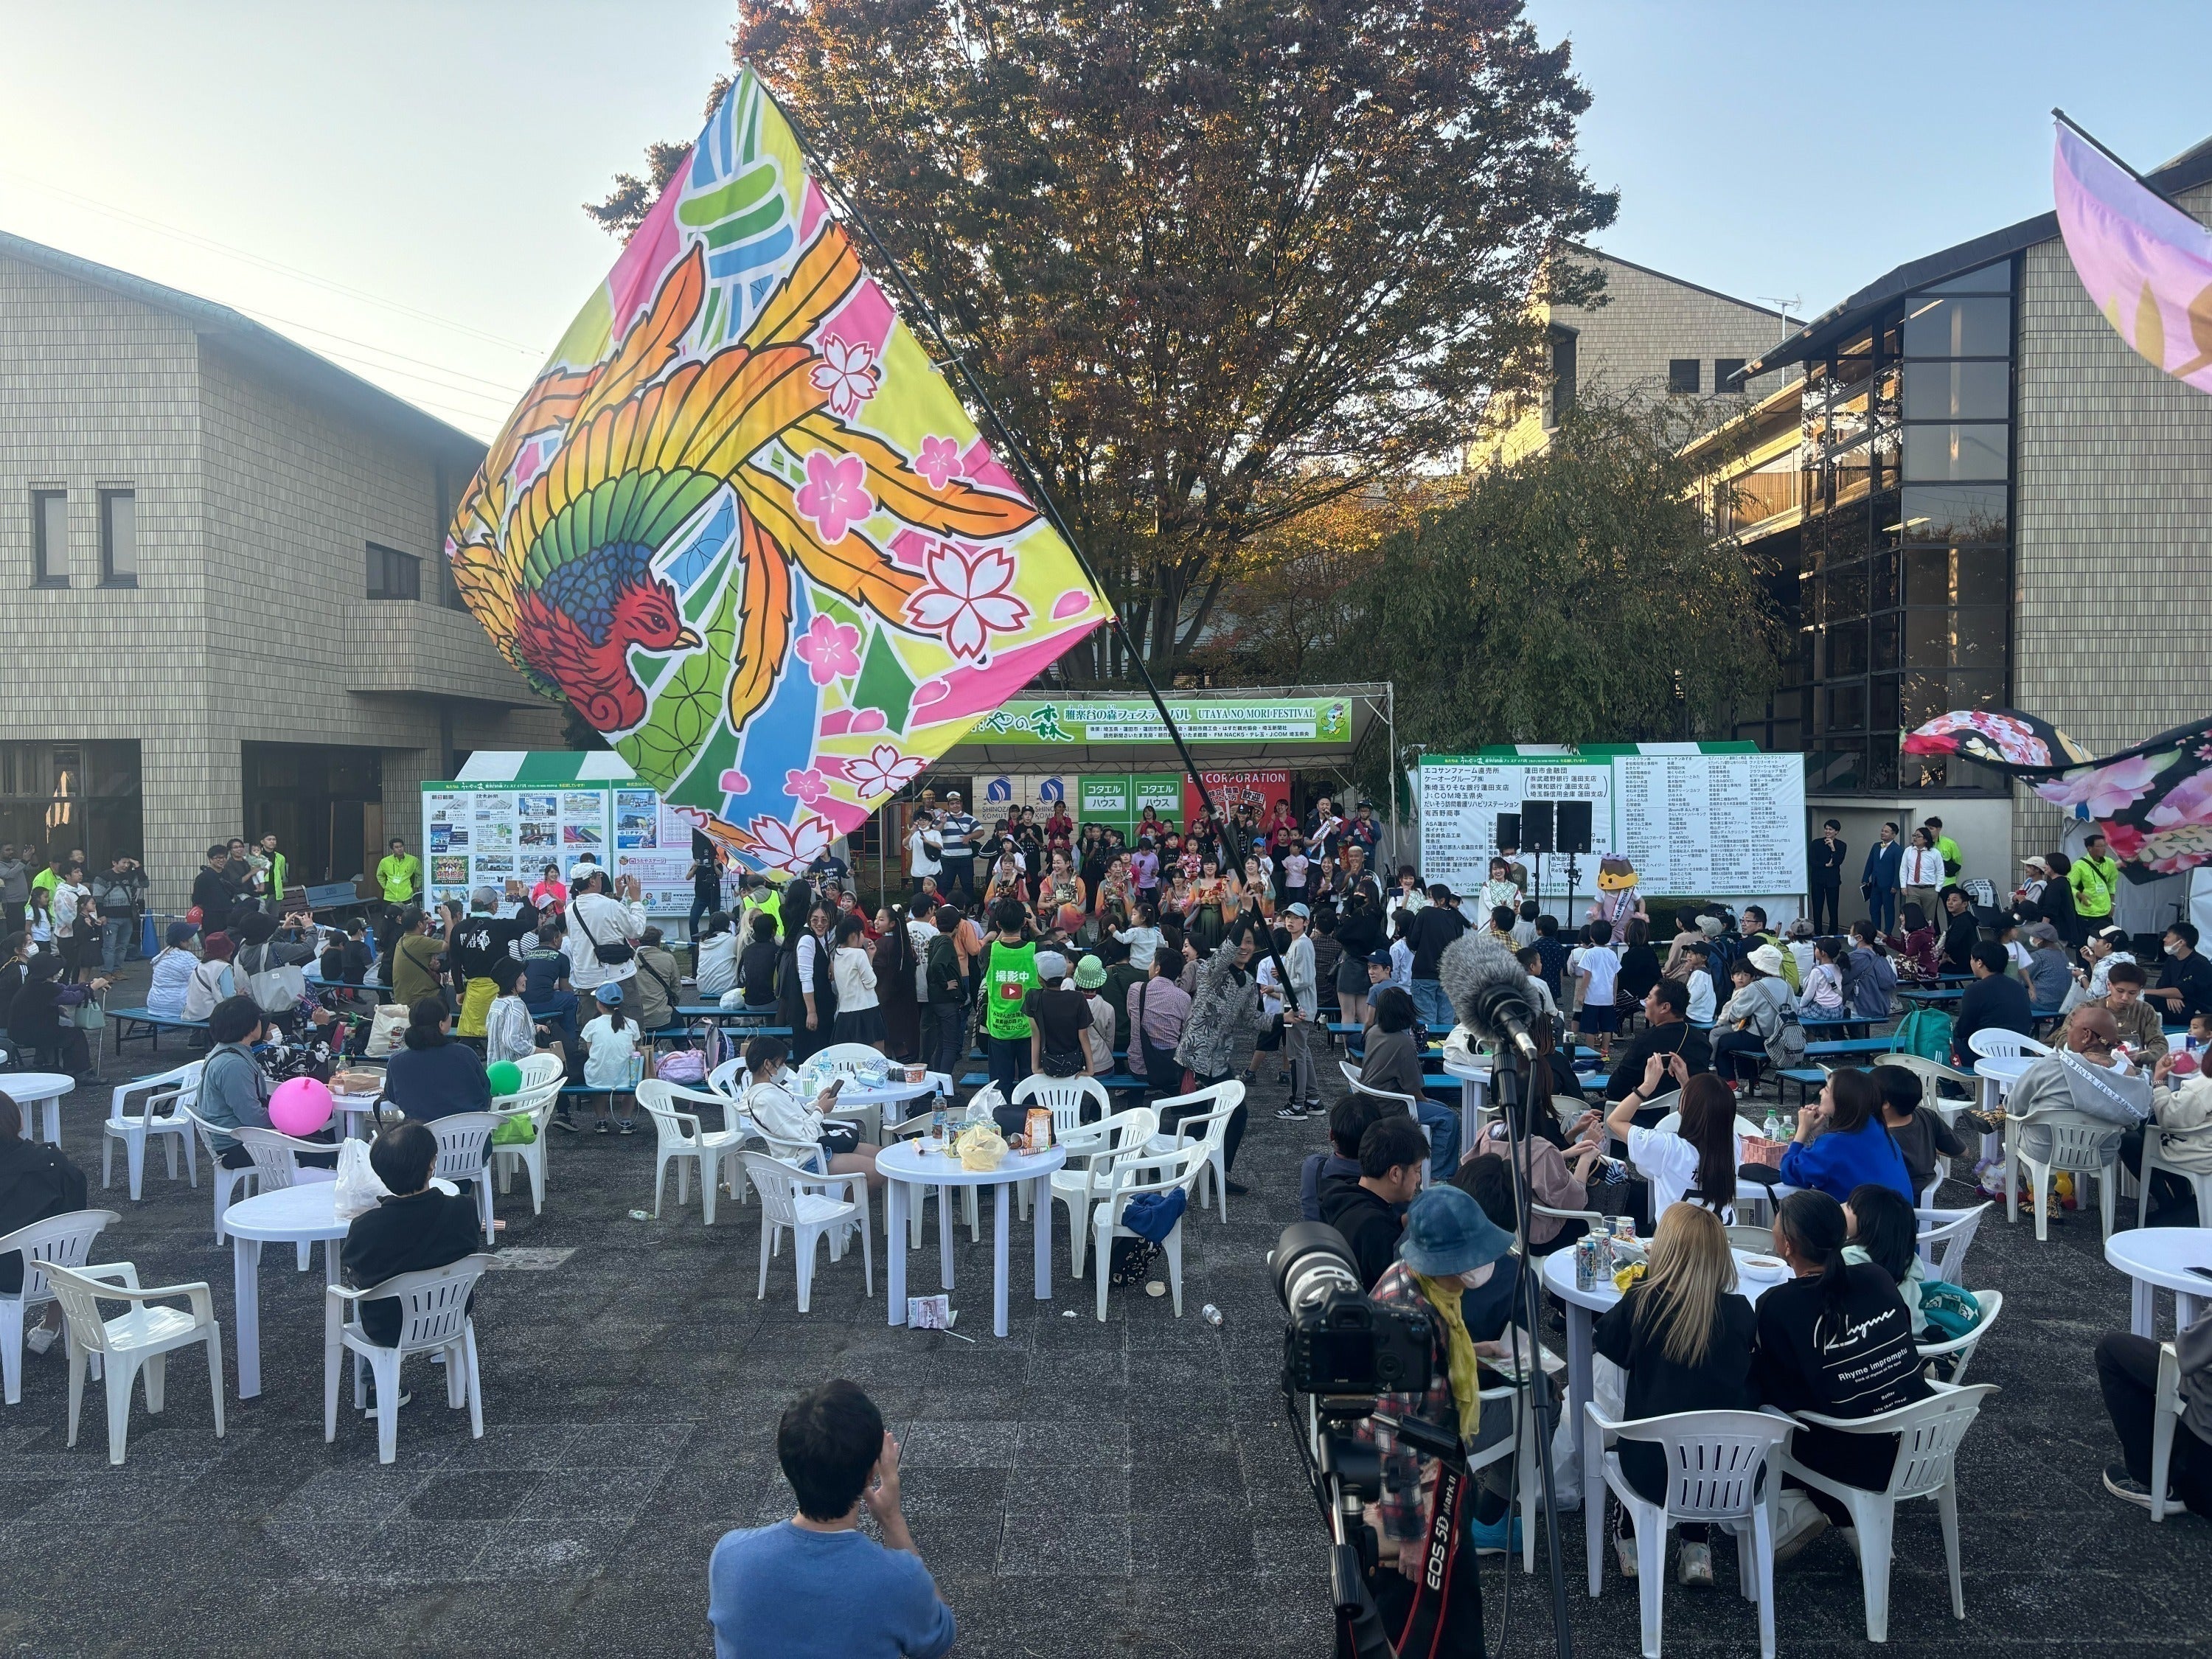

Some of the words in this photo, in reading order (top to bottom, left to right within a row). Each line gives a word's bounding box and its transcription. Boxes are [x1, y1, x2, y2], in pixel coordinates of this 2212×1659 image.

[1065, 709, 1189, 721] 雅楽谷の森フェステバル
[1199, 709, 1229, 719] UTAYA
[1231, 709, 1244, 719] NO
[1246, 709, 1270, 719] MORI
[1273, 708, 1315, 718] FESTIVAL
[1188, 774, 1203, 783] E
[1206, 773, 1286, 784] CORPORATION
[1093, 799, 1116, 807] ハウス
[1146, 799, 1169, 807] ハウス
[995, 970, 1029, 982] 撮影中
[1838, 1367, 1868, 1381] Rhyme
[1443, 1486, 1455, 1515] Mark
[1435, 1515, 1449, 1543] 5D
[1427, 1541, 1445, 1591] EOS
